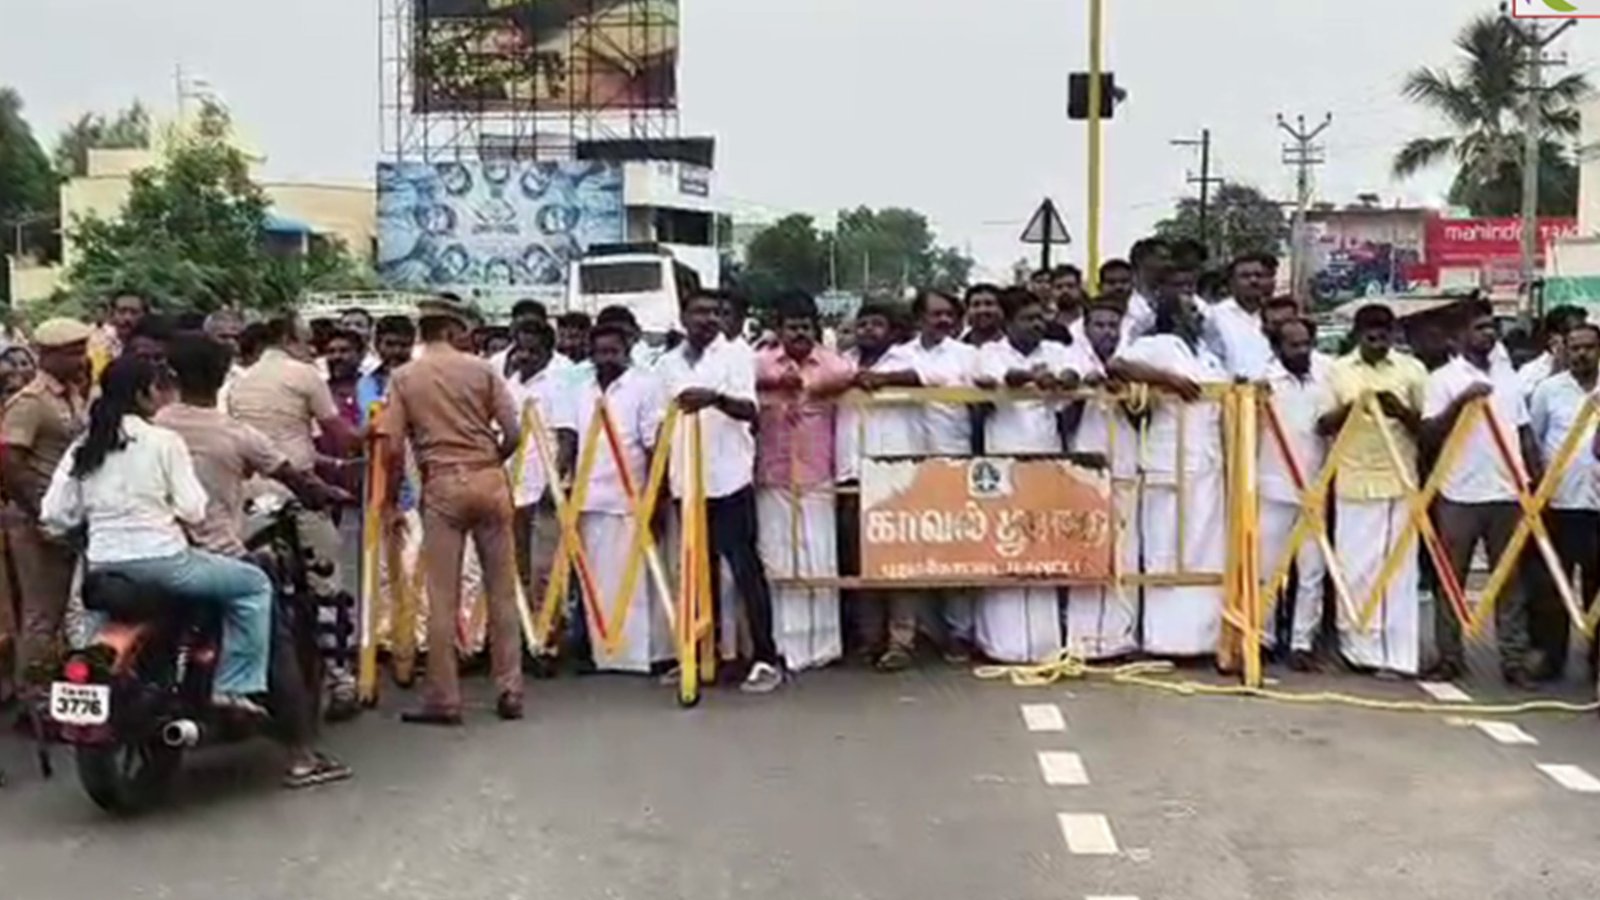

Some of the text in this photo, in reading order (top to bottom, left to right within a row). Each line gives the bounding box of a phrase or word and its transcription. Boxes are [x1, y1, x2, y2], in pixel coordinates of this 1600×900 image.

[1445, 221, 1523, 241] mahindr
[868, 501, 986, 544] காவல்
[56, 697, 102, 715] 3776
